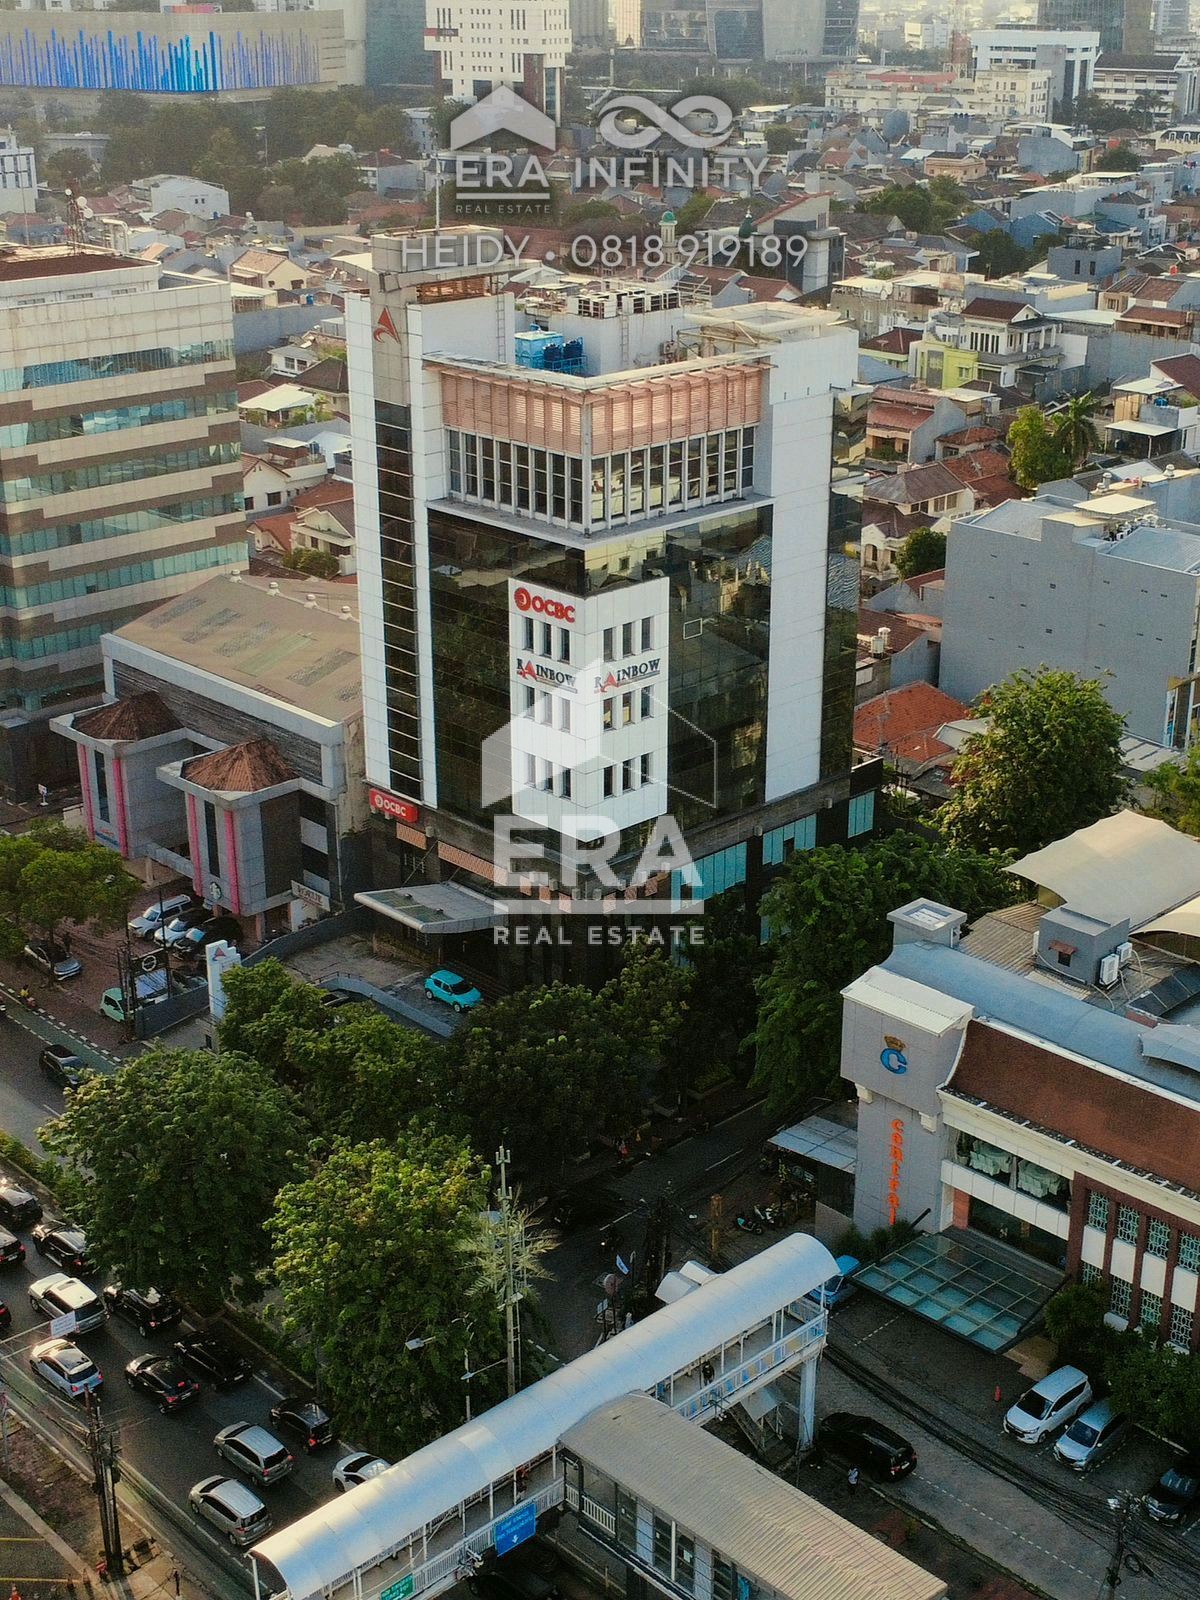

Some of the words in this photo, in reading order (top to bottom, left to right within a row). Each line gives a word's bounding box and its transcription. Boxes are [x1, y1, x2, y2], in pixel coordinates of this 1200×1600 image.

[532, 596, 575, 623] OCBC
[516, 658, 576, 687] RAINBOW
[383, 802, 407, 816] OCBC
